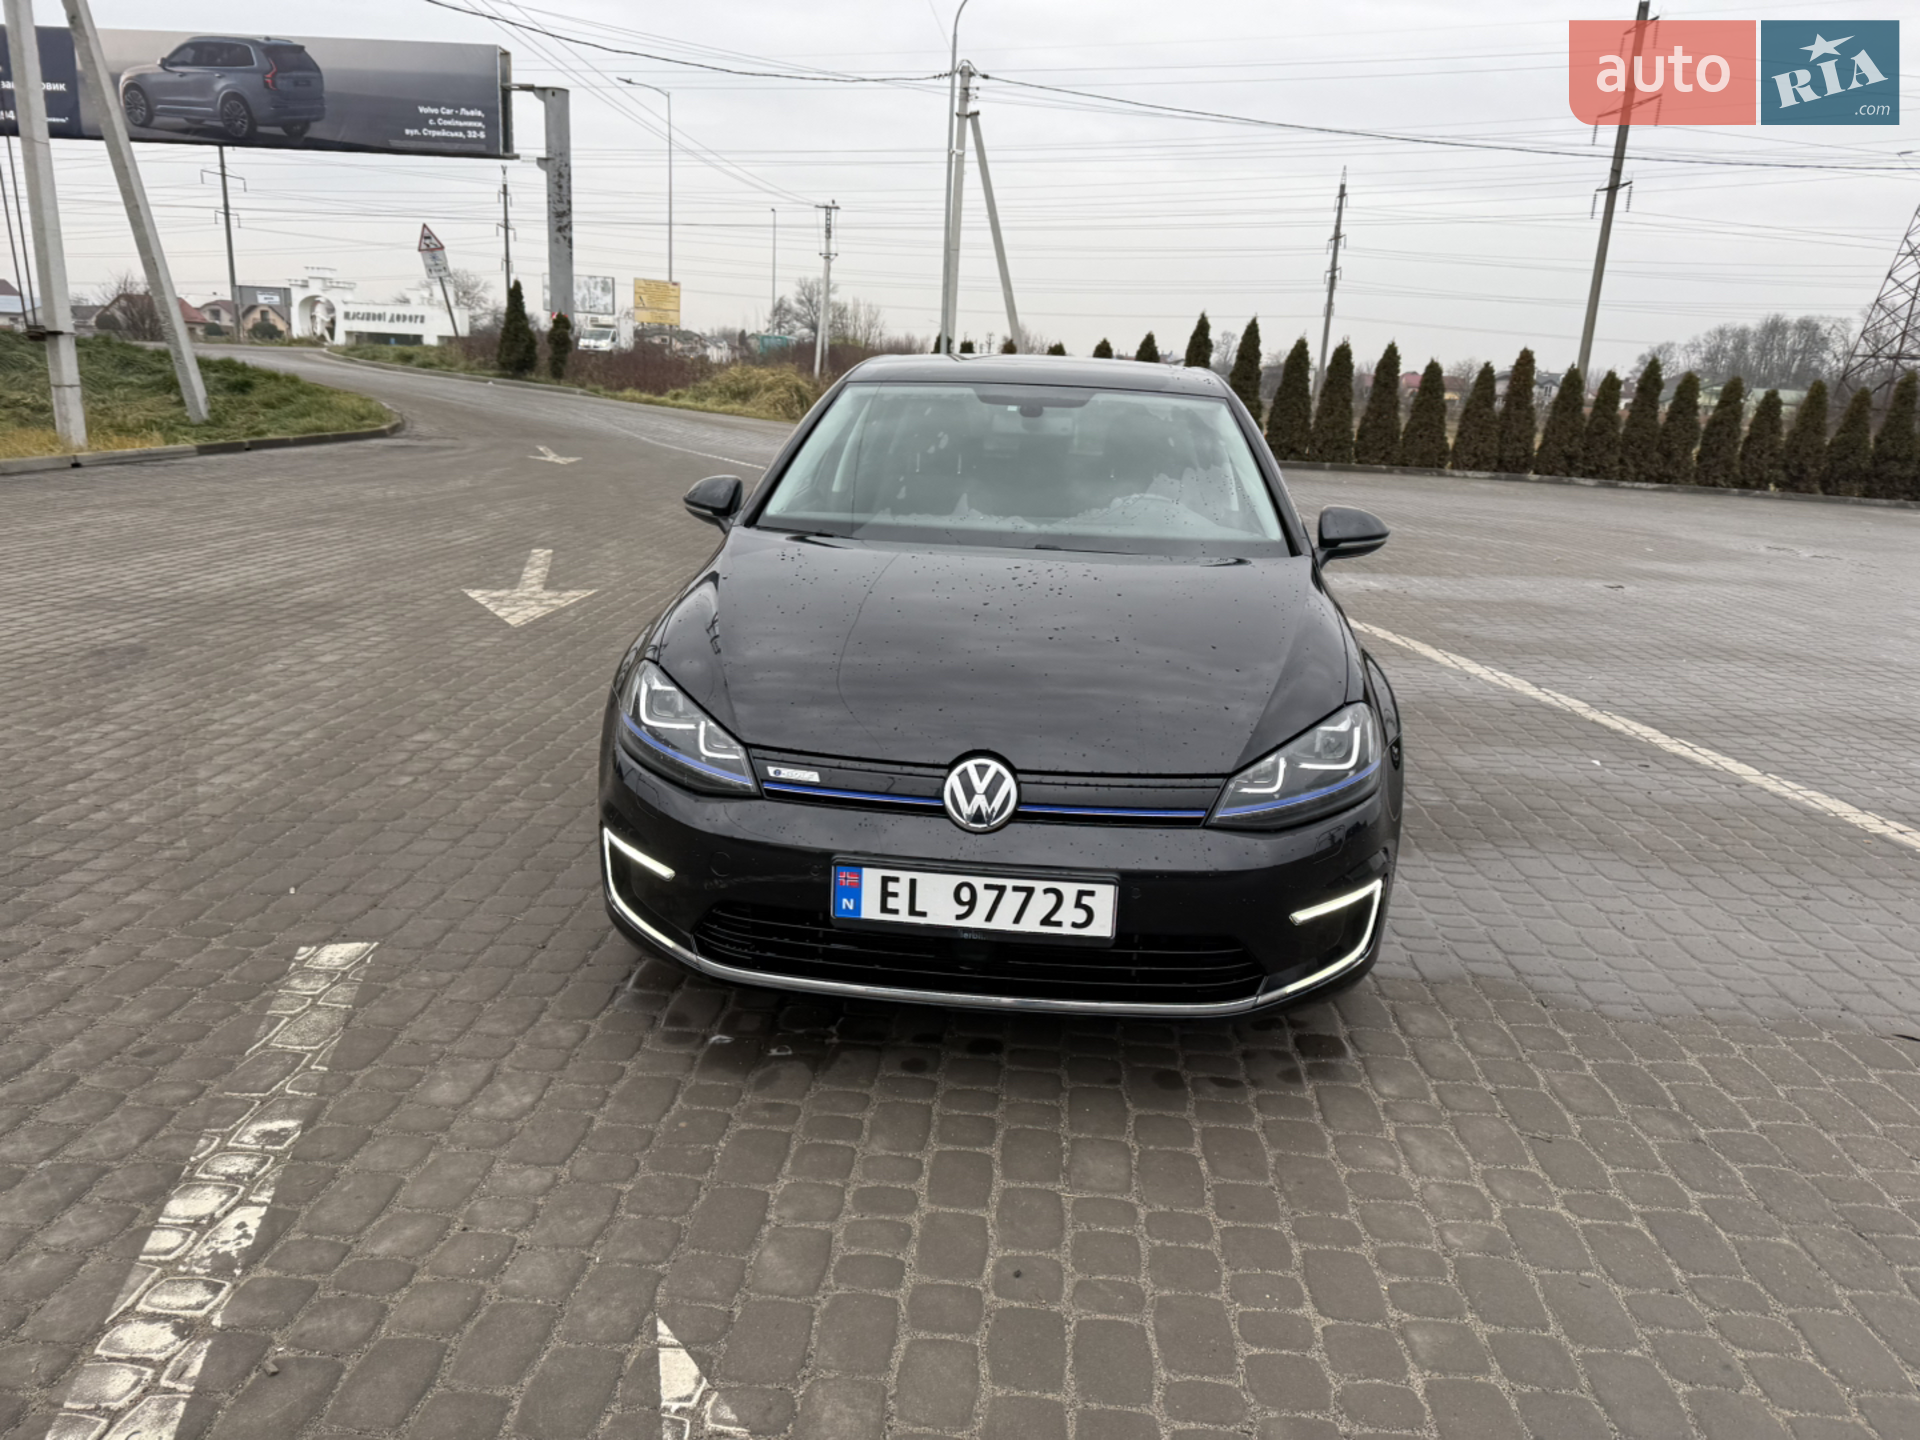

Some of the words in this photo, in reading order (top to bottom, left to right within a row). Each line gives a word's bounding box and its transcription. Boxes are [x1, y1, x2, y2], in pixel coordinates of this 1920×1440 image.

[418, 106, 439, 114] Volvo
[440, 107, 454, 115] Car
[404, 128, 421, 137] вул.
[842, 898, 854, 910] N
[879, 875, 928, 918] EL
[952, 881, 1097, 930] 97725
